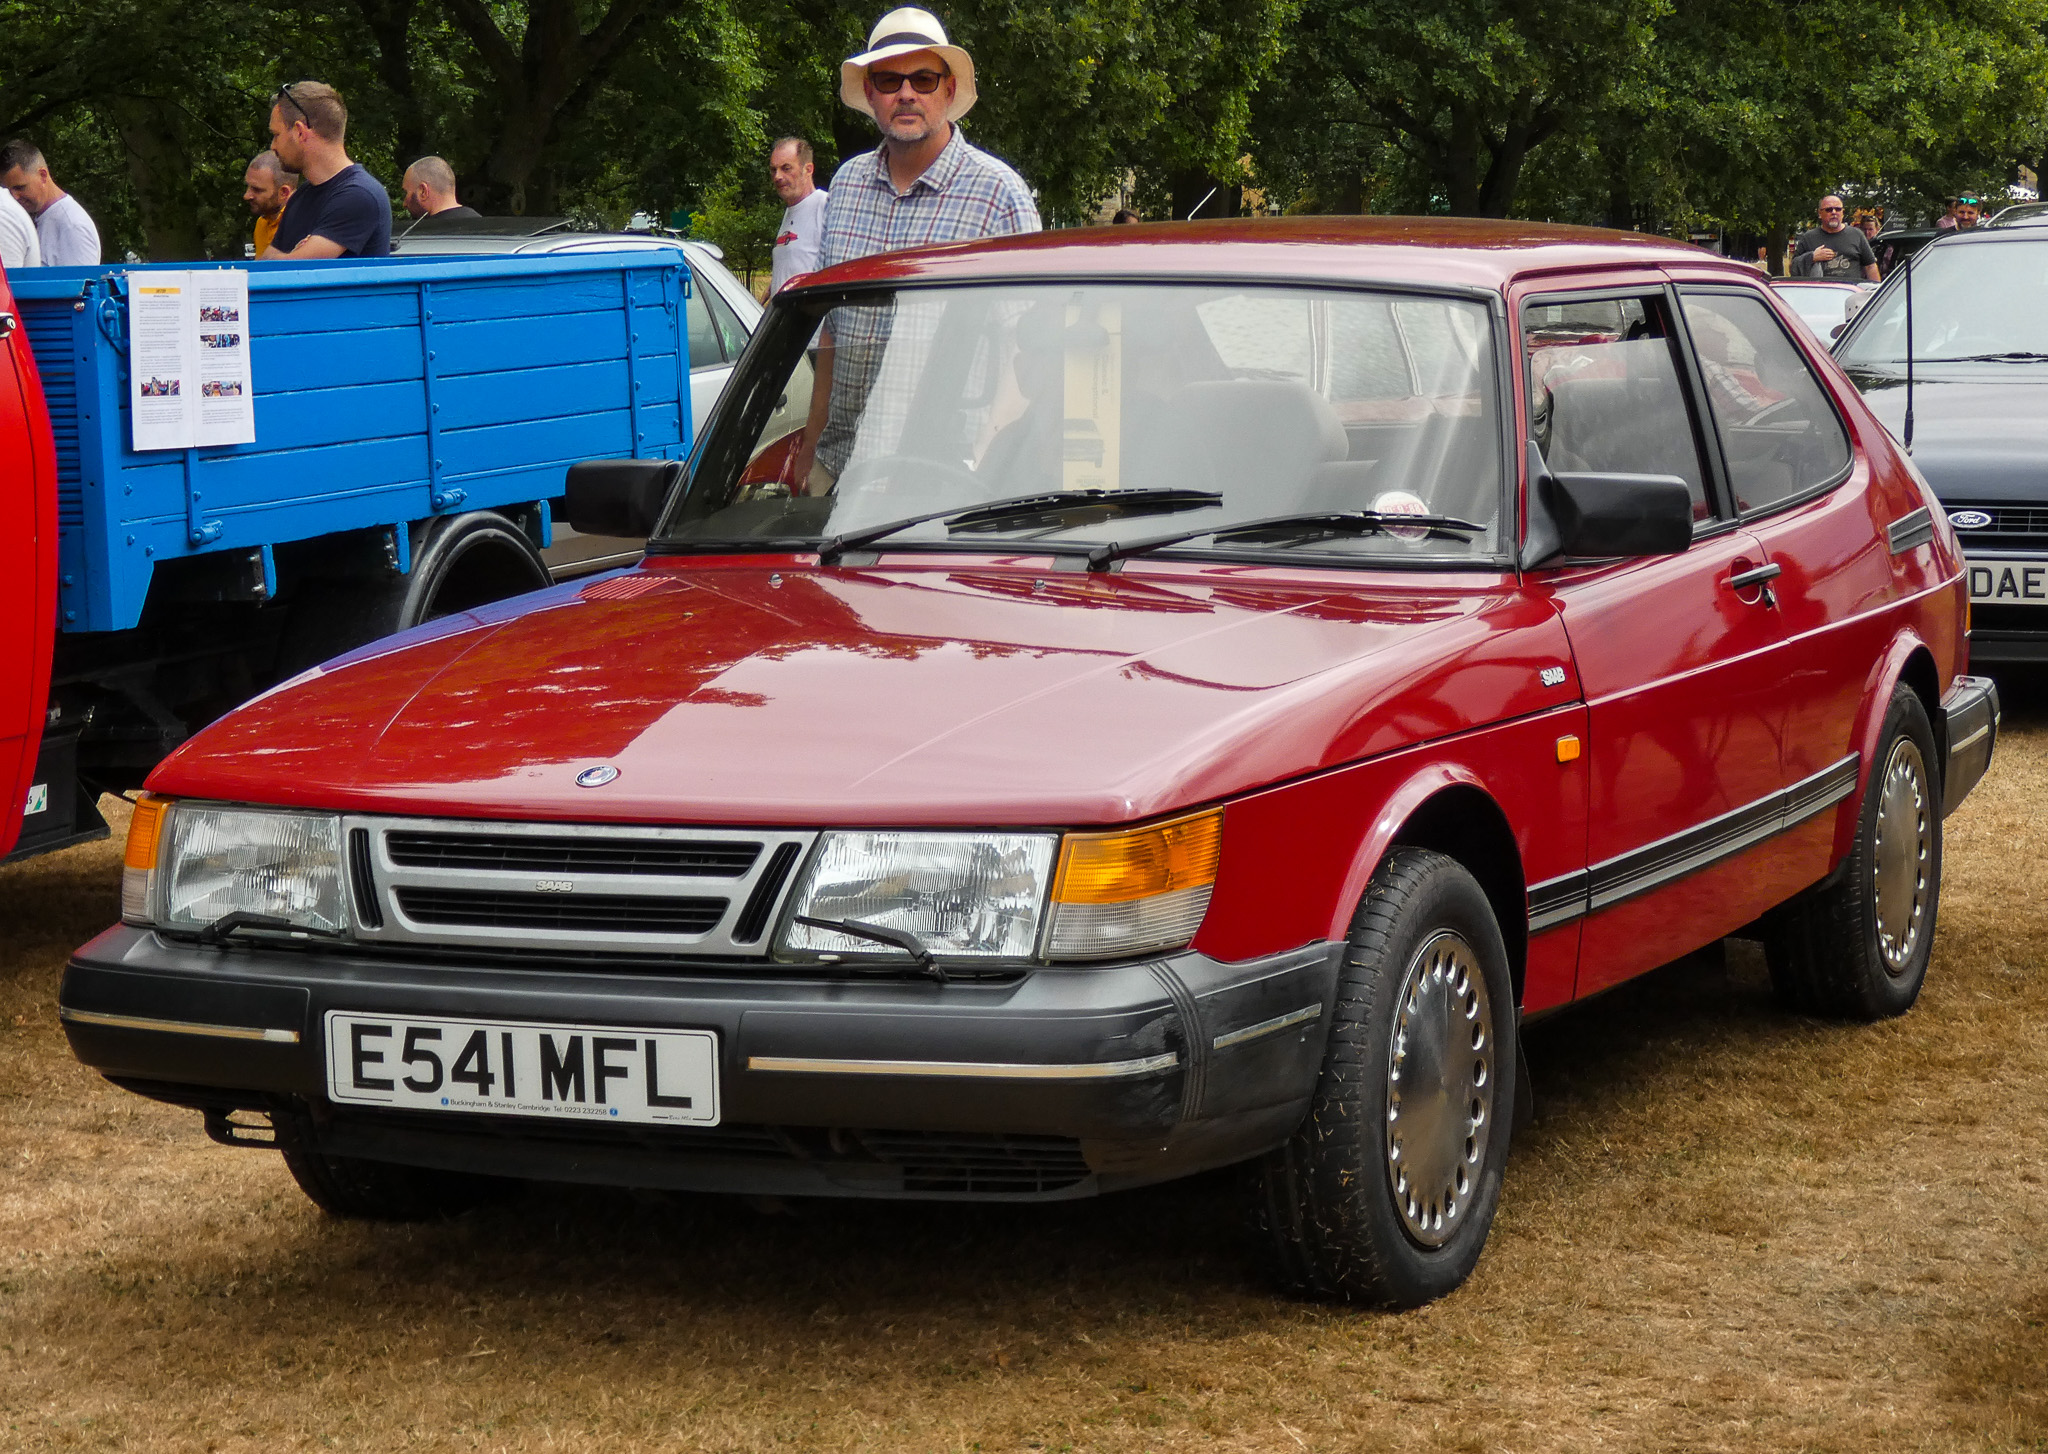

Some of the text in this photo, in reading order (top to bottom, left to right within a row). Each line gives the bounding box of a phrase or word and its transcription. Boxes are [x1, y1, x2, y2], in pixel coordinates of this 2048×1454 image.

[1957, 514, 1981, 524] Ford
[1970, 567, 2046, 598] DAE
[1540, 666, 1566, 687] SAAB
[536, 880, 573, 892] SAAB
[350, 1023, 692, 1109] E541 MFL
[450, 1099, 487, 1108] Buckingham
[494, 1101, 516, 1110] Stanley
[517, 1103, 550, 1112] Cambridge
